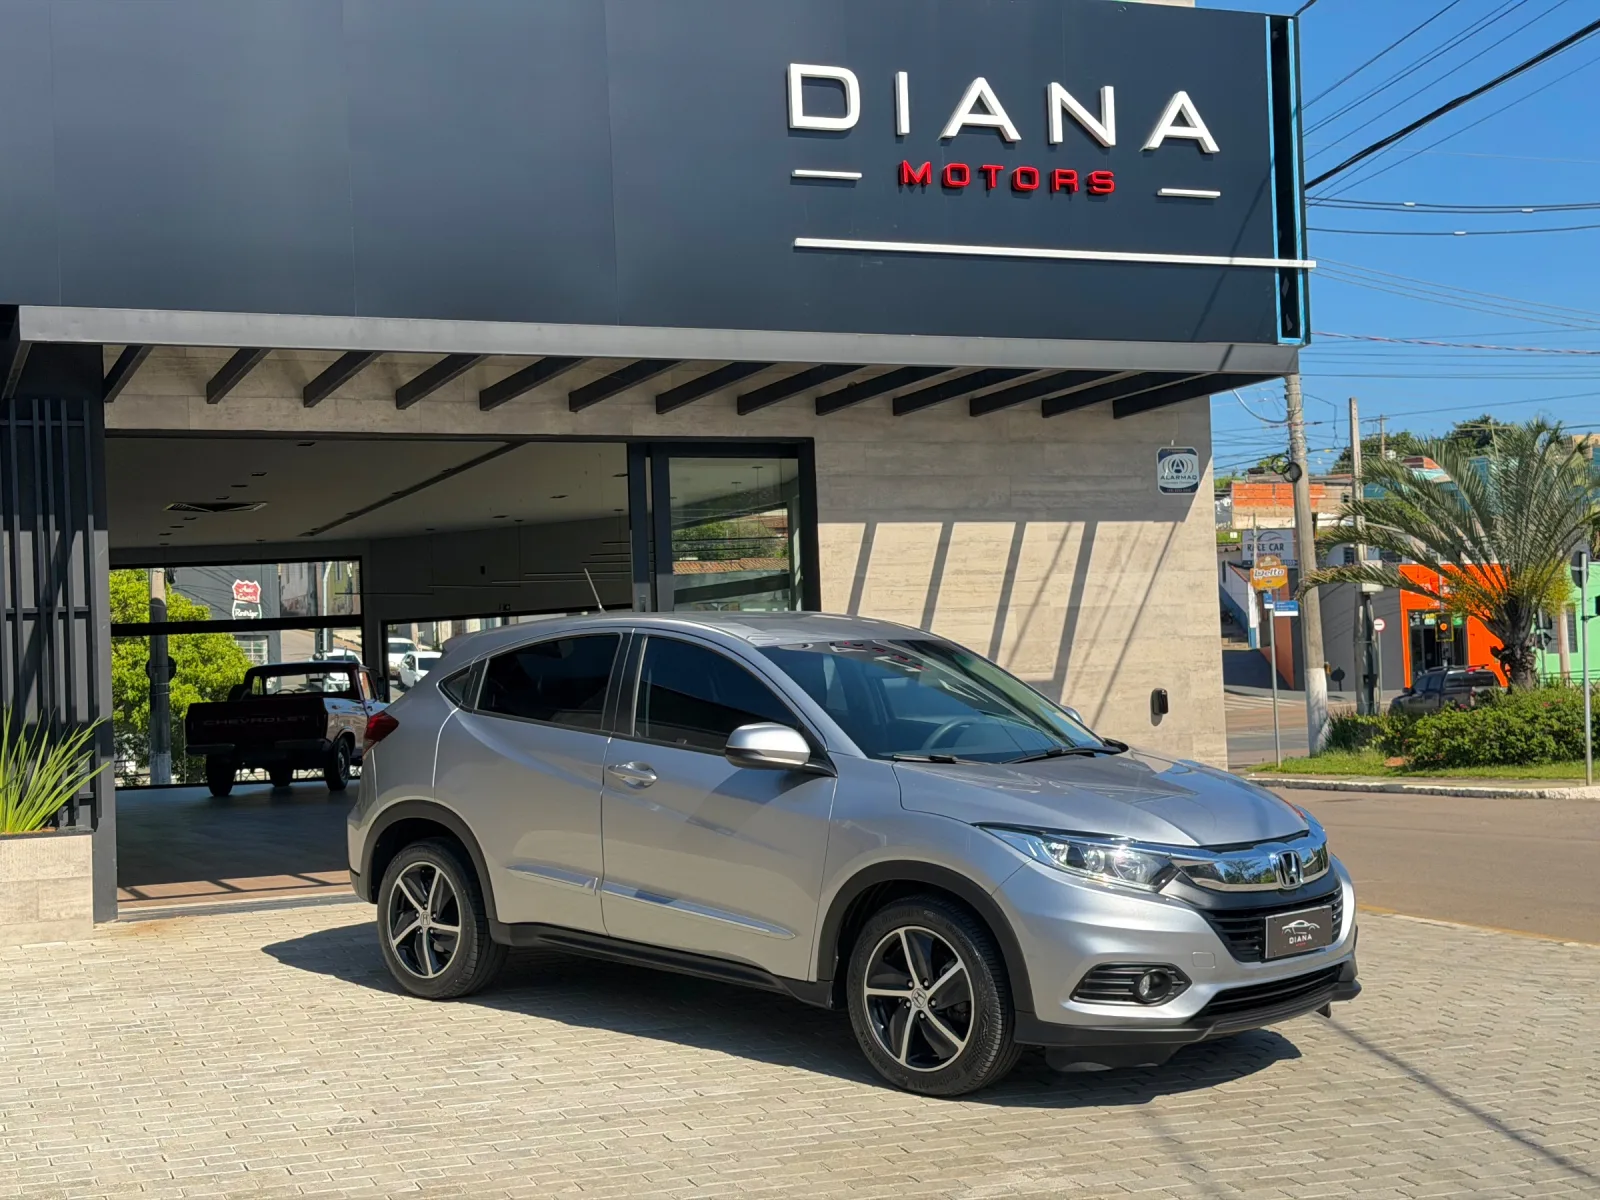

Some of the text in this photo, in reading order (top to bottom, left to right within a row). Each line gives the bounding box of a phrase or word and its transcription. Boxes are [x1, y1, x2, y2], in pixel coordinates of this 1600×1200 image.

[787, 62, 1220, 153] DIANA
[899, 159, 1116, 195] MOTORS
[1247, 543, 1284, 551] RCE CAR
[203, 715, 308, 725] CHEVROLET
[1289, 934, 1312, 944] DIANA
